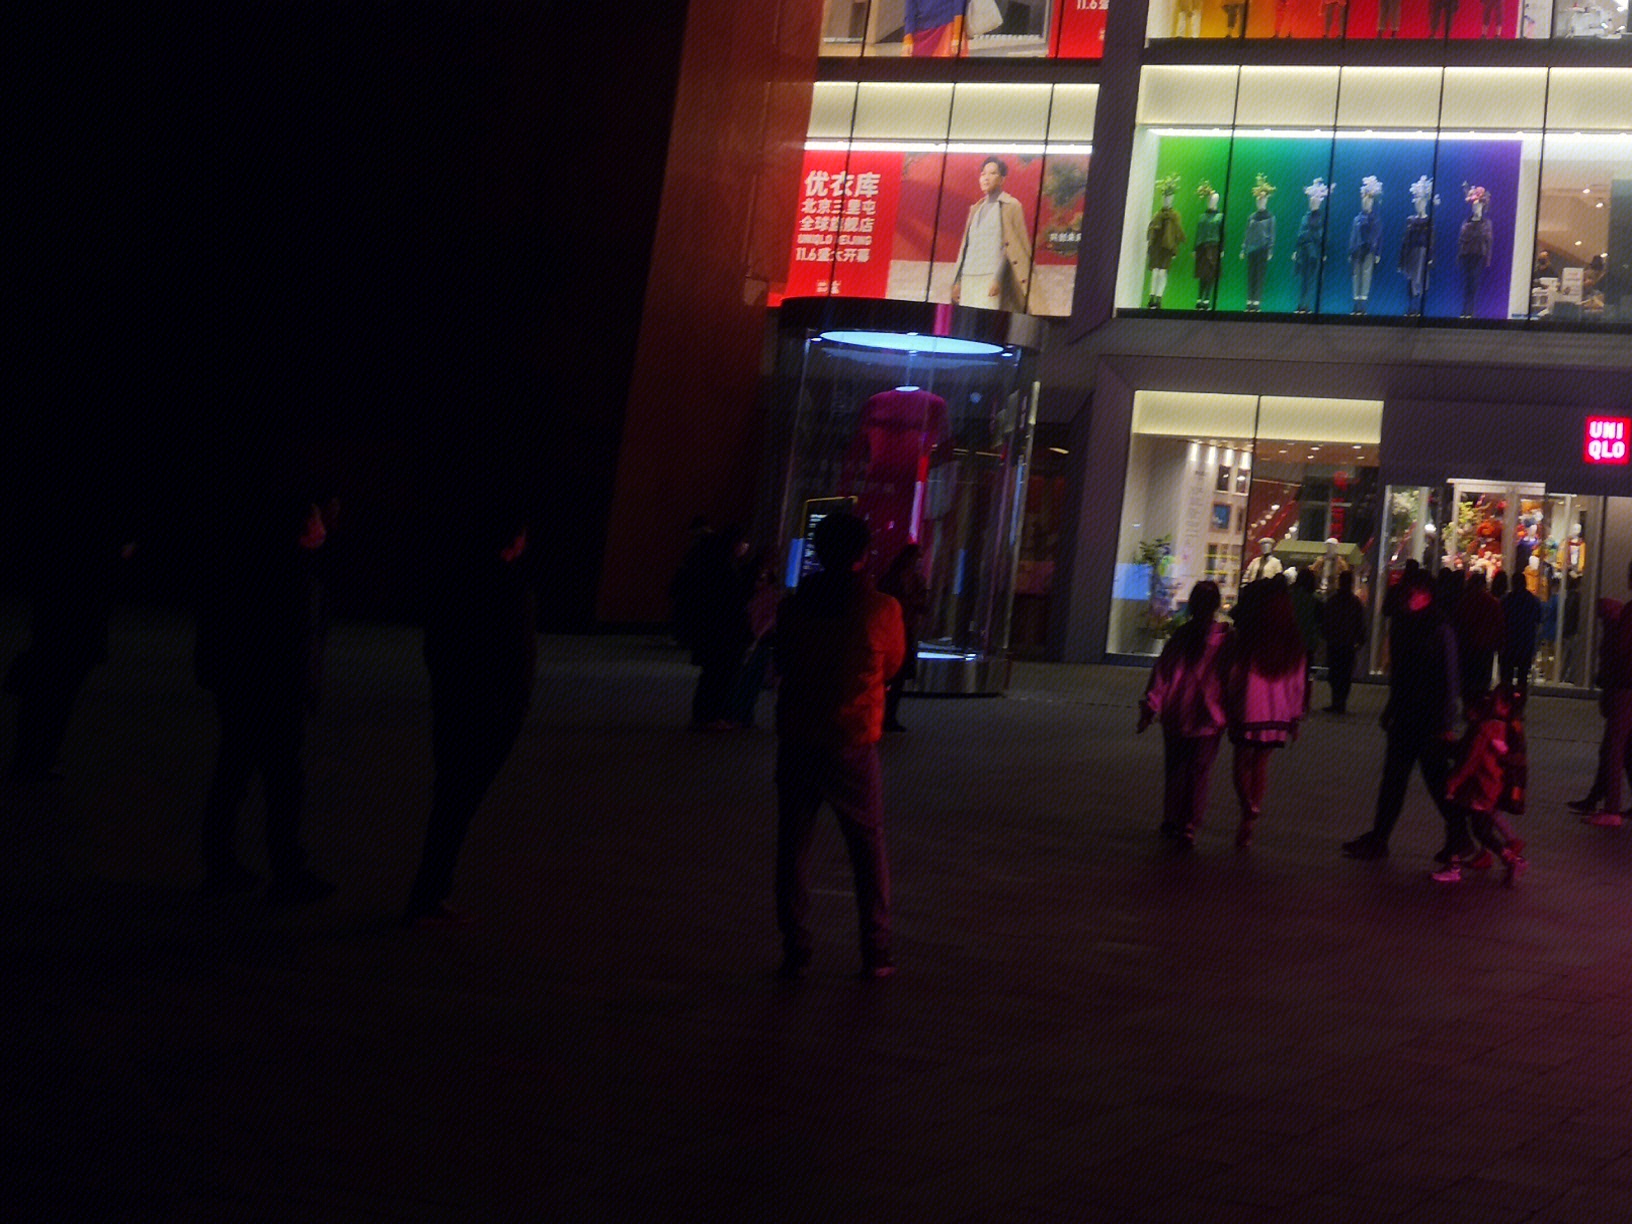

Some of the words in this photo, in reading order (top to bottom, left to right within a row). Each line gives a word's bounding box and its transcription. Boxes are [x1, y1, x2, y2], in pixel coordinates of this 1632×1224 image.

[804, 170, 881, 198] 优衣库
[1589, 421, 1624, 440] UNI
[1588, 440, 1626, 460] QLO
